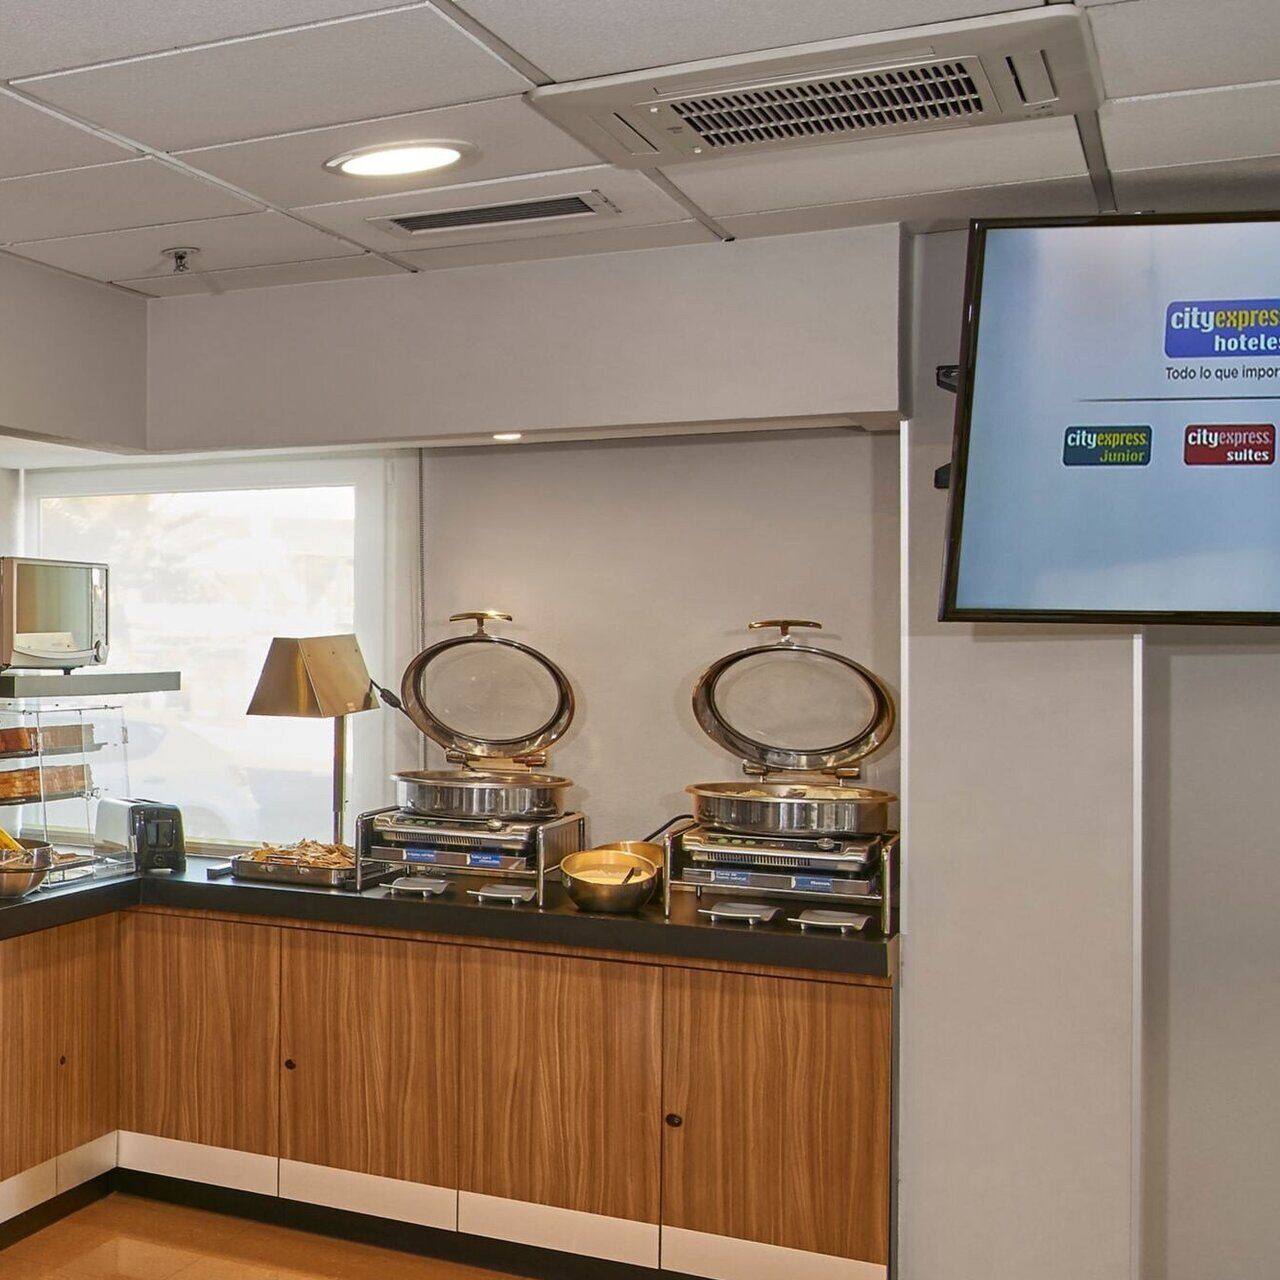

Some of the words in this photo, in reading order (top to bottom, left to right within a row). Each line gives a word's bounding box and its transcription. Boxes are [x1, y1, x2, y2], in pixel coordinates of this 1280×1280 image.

[1171, 307, 1280, 333] cityexpres
[1214, 334, 1280, 352] hotele
[1166, 366, 1197, 380] Todo
[1200, 365, 1211, 379] lo
[1215, 368, 1239, 381] que
[1067, 430, 1146, 448] cityexpress
[1188, 429, 1270, 448] cityexpress
[1100, 449, 1145, 463] Junior
[1227, 448, 1269, 461] suites
